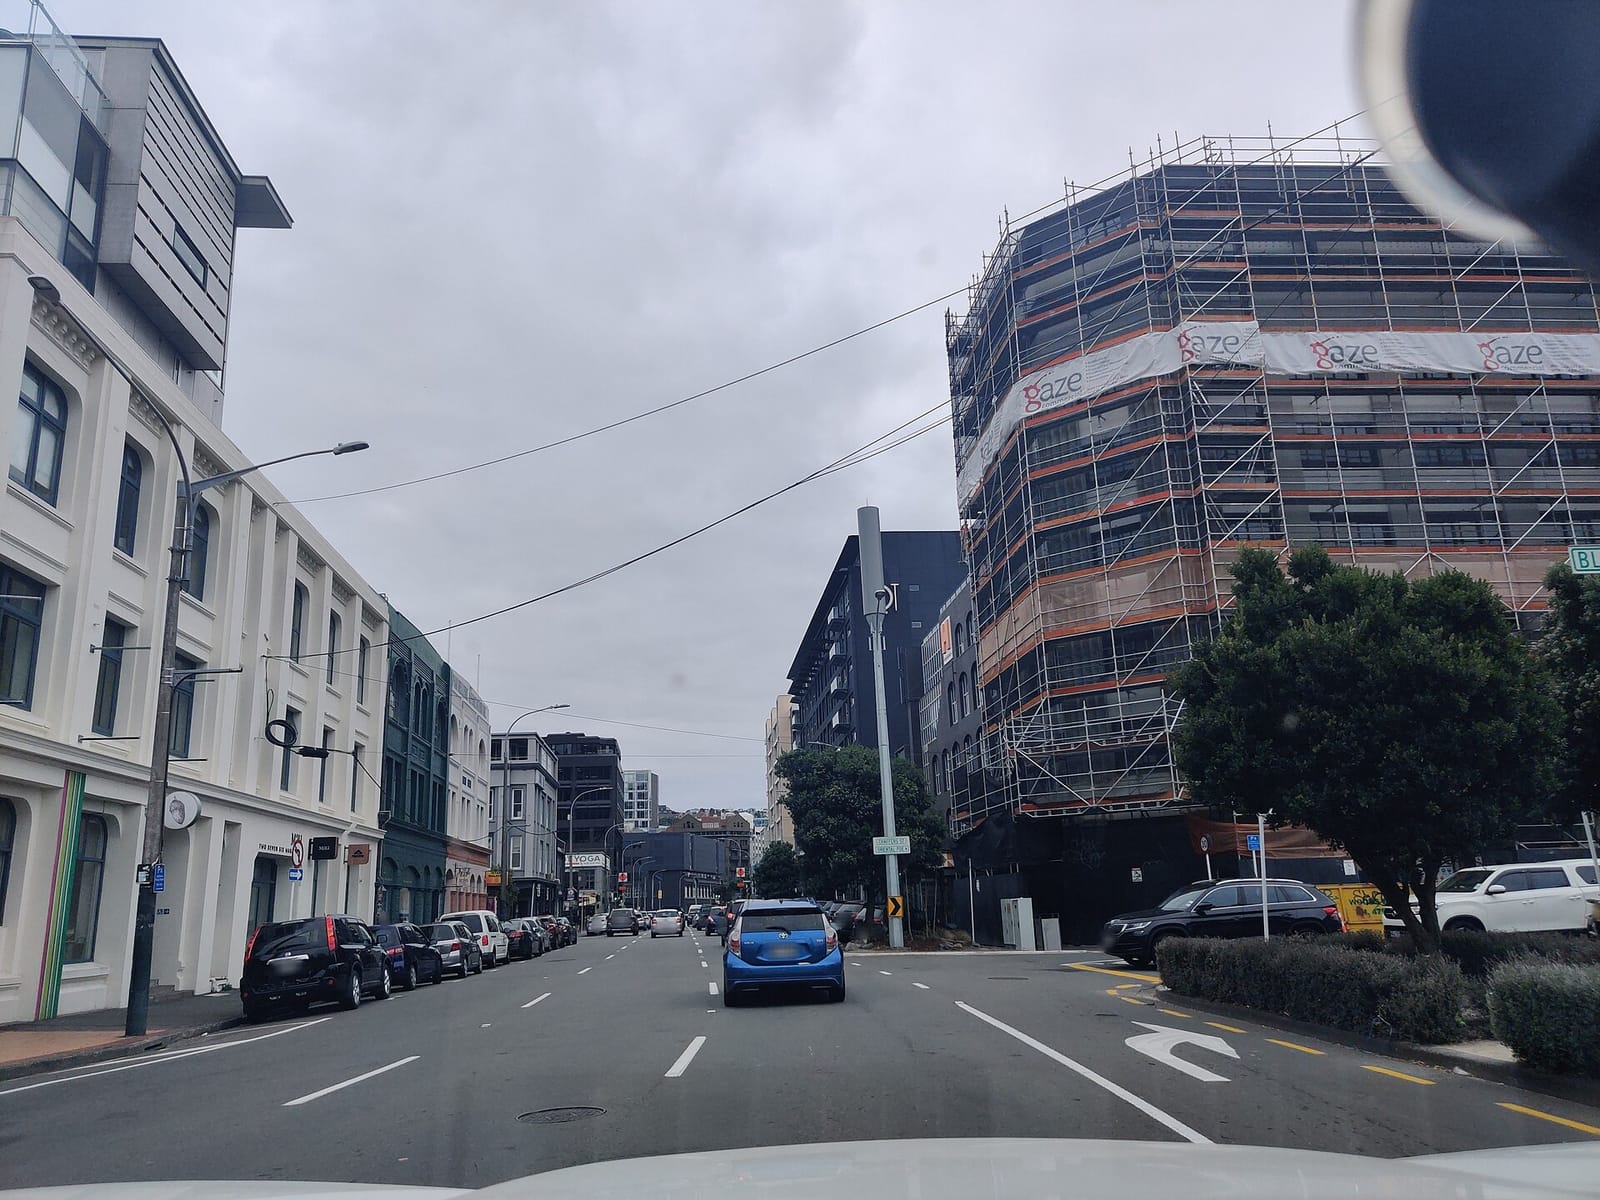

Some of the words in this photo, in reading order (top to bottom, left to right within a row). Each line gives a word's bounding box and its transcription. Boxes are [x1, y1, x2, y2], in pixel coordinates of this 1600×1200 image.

[1178, 330, 1239, 362] gaze
[1311, 340, 1379, 370] gaze
[1477, 341, 1543, 371] gaze
[1023, 371, 1083, 413] gaze
